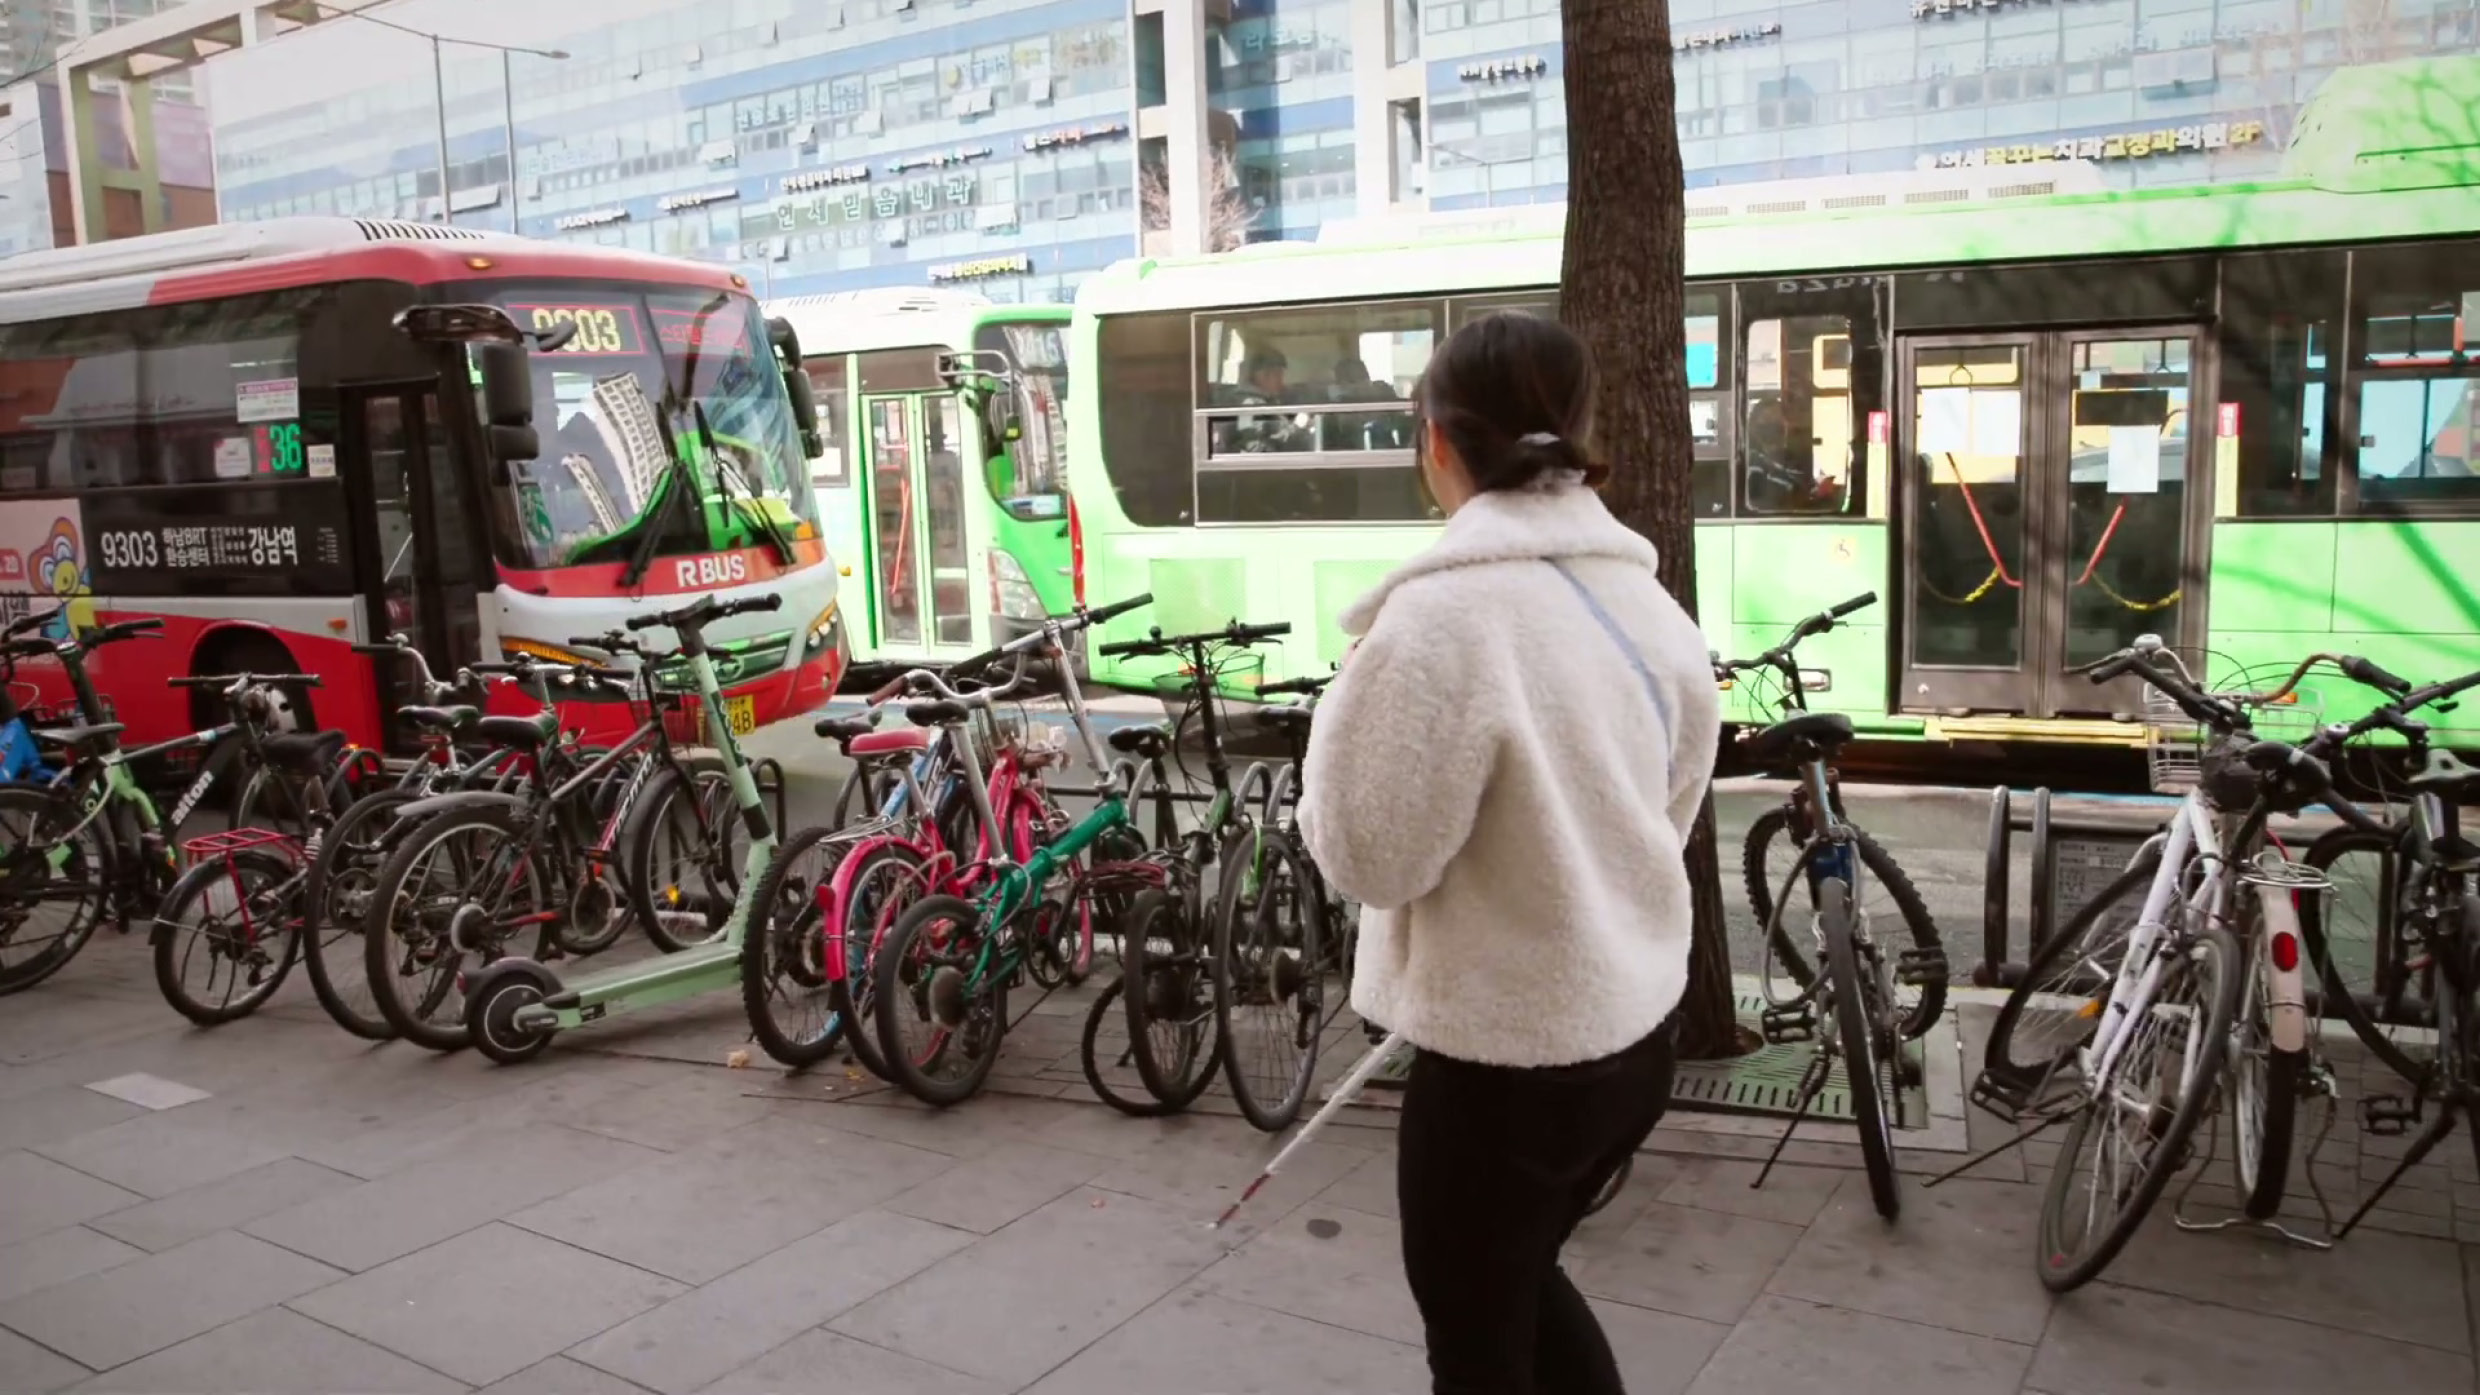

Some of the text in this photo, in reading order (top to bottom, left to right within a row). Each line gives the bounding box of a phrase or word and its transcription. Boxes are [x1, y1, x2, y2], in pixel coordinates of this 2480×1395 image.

[270, 423, 302, 470] 36
[101, 531, 158, 567] 9303
[162, 527, 207, 547] 하남BRT
[248, 526, 298, 565] 강남역
[165, 547, 210, 567] 환승센터
